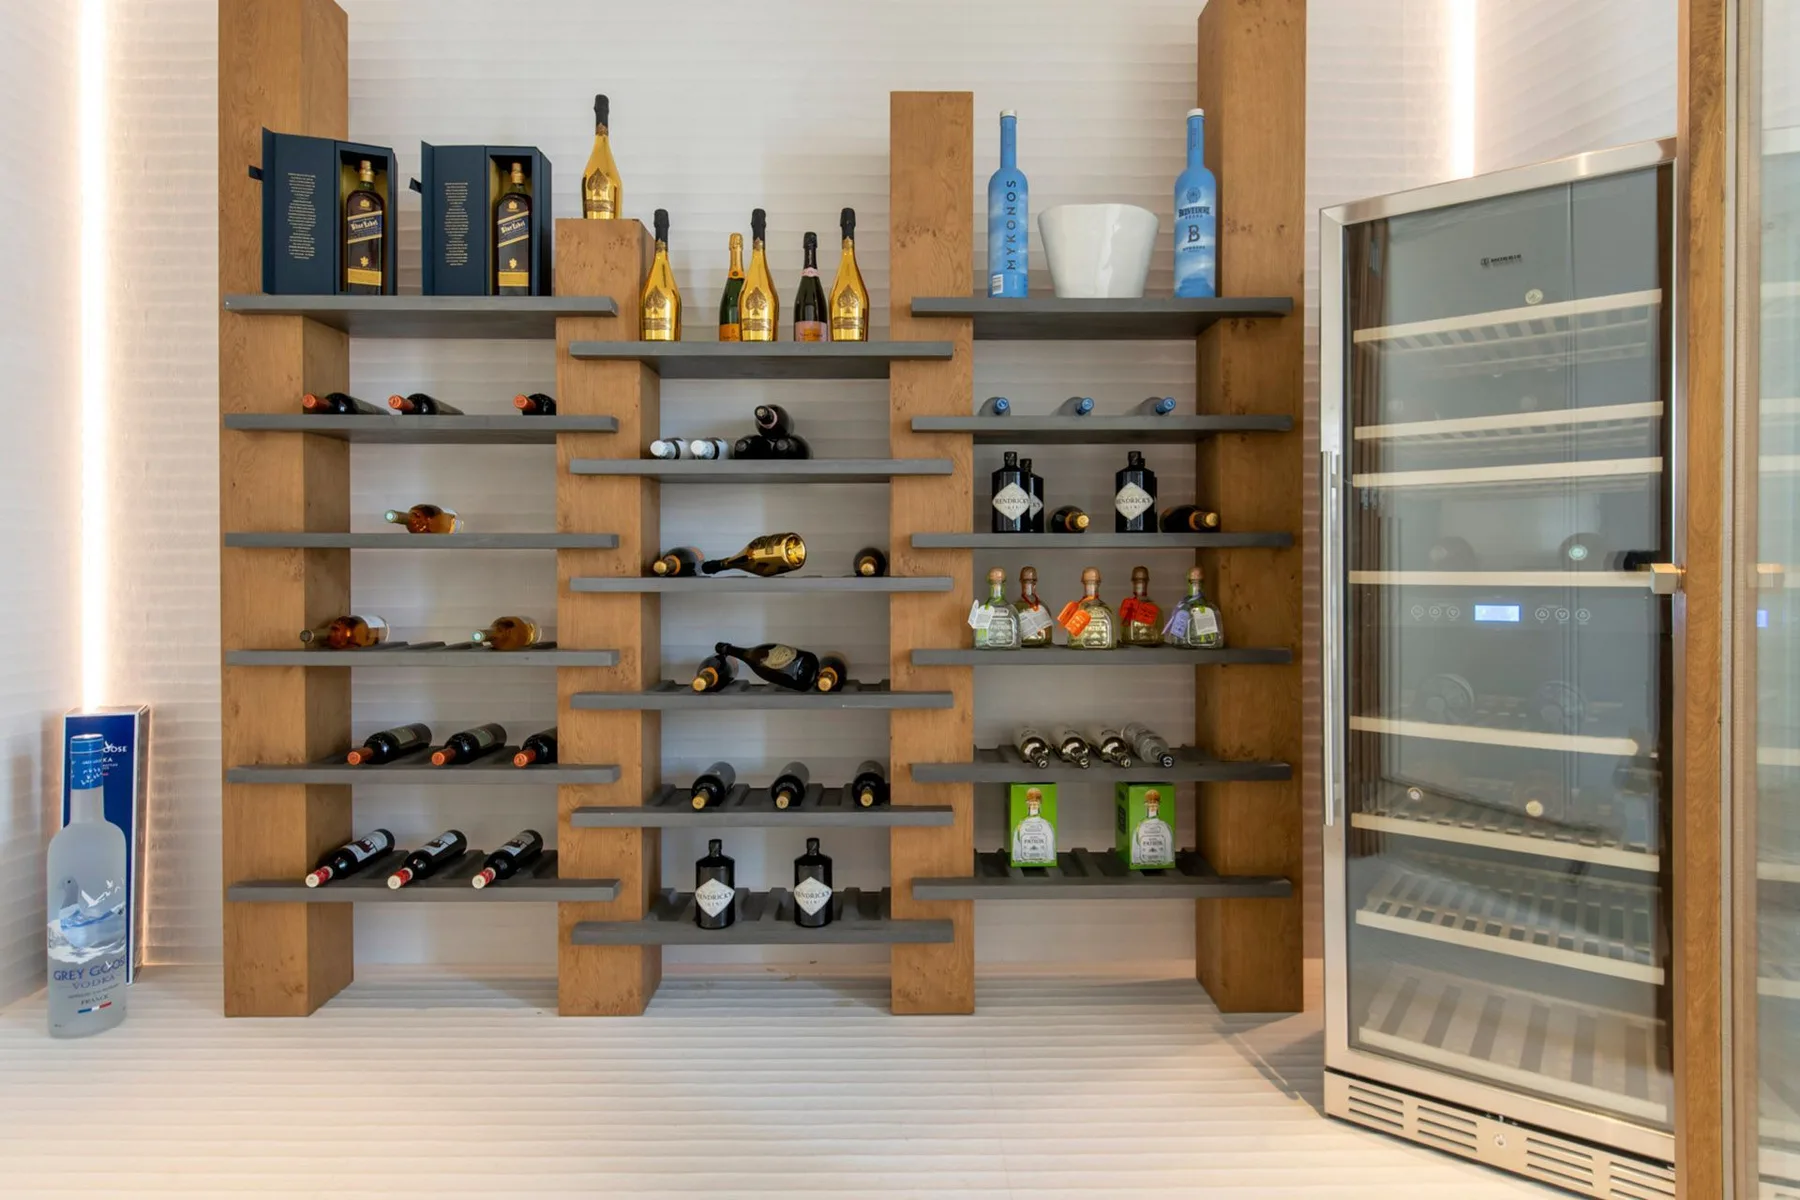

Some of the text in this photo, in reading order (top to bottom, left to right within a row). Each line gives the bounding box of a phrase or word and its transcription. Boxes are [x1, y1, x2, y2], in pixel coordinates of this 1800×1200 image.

[1006, 180, 1017, 270] MYKONOS
[102, 745, 128, 753] OOSE
[53, 955, 125, 981] GREY GOOS
[72, 974, 116, 990] VODKA
[81, 994, 109, 1005] FRANCE
